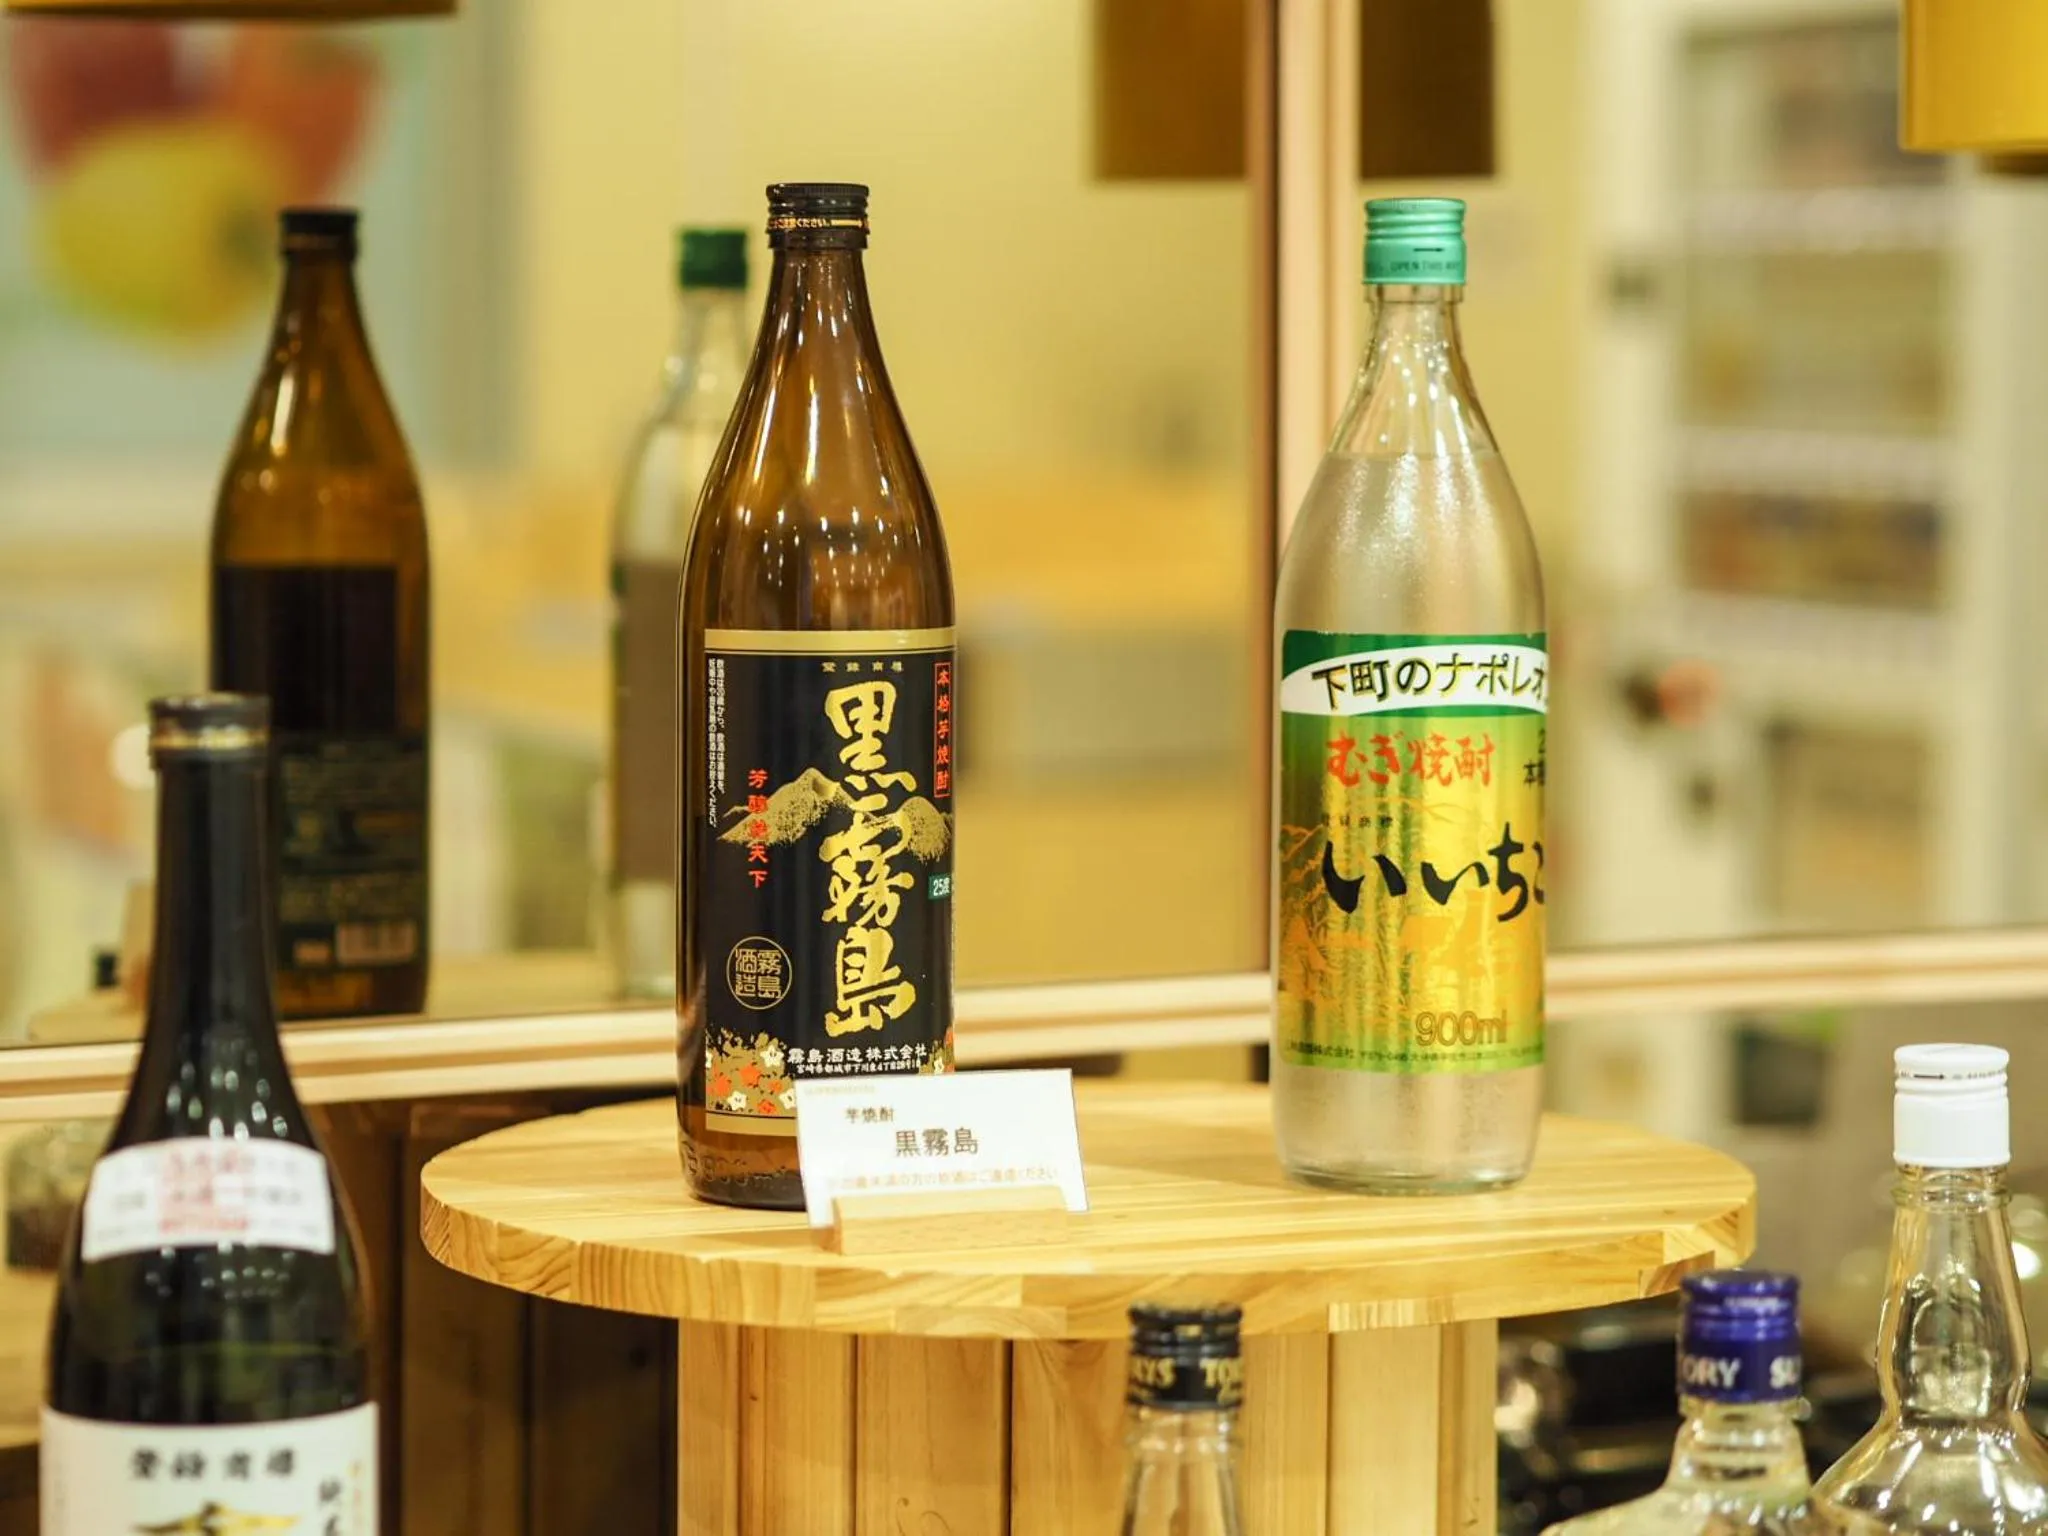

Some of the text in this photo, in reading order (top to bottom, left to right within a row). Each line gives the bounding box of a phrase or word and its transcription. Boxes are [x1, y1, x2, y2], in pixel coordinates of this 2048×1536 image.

[937, 669, 950, 790] 本格芋焼酎
[1325, 730, 1496, 788] むぎ焼酎
[819, 680, 917, 1038] 黒霧島
[1415, 1011, 1508, 1047] 900ml
[787, 1043, 928, 1065] 霧島酒造株式会社
[845, 1105, 895, 1124] 芋焼酎
[895, 1127, 978, 1157] 黒霧島
